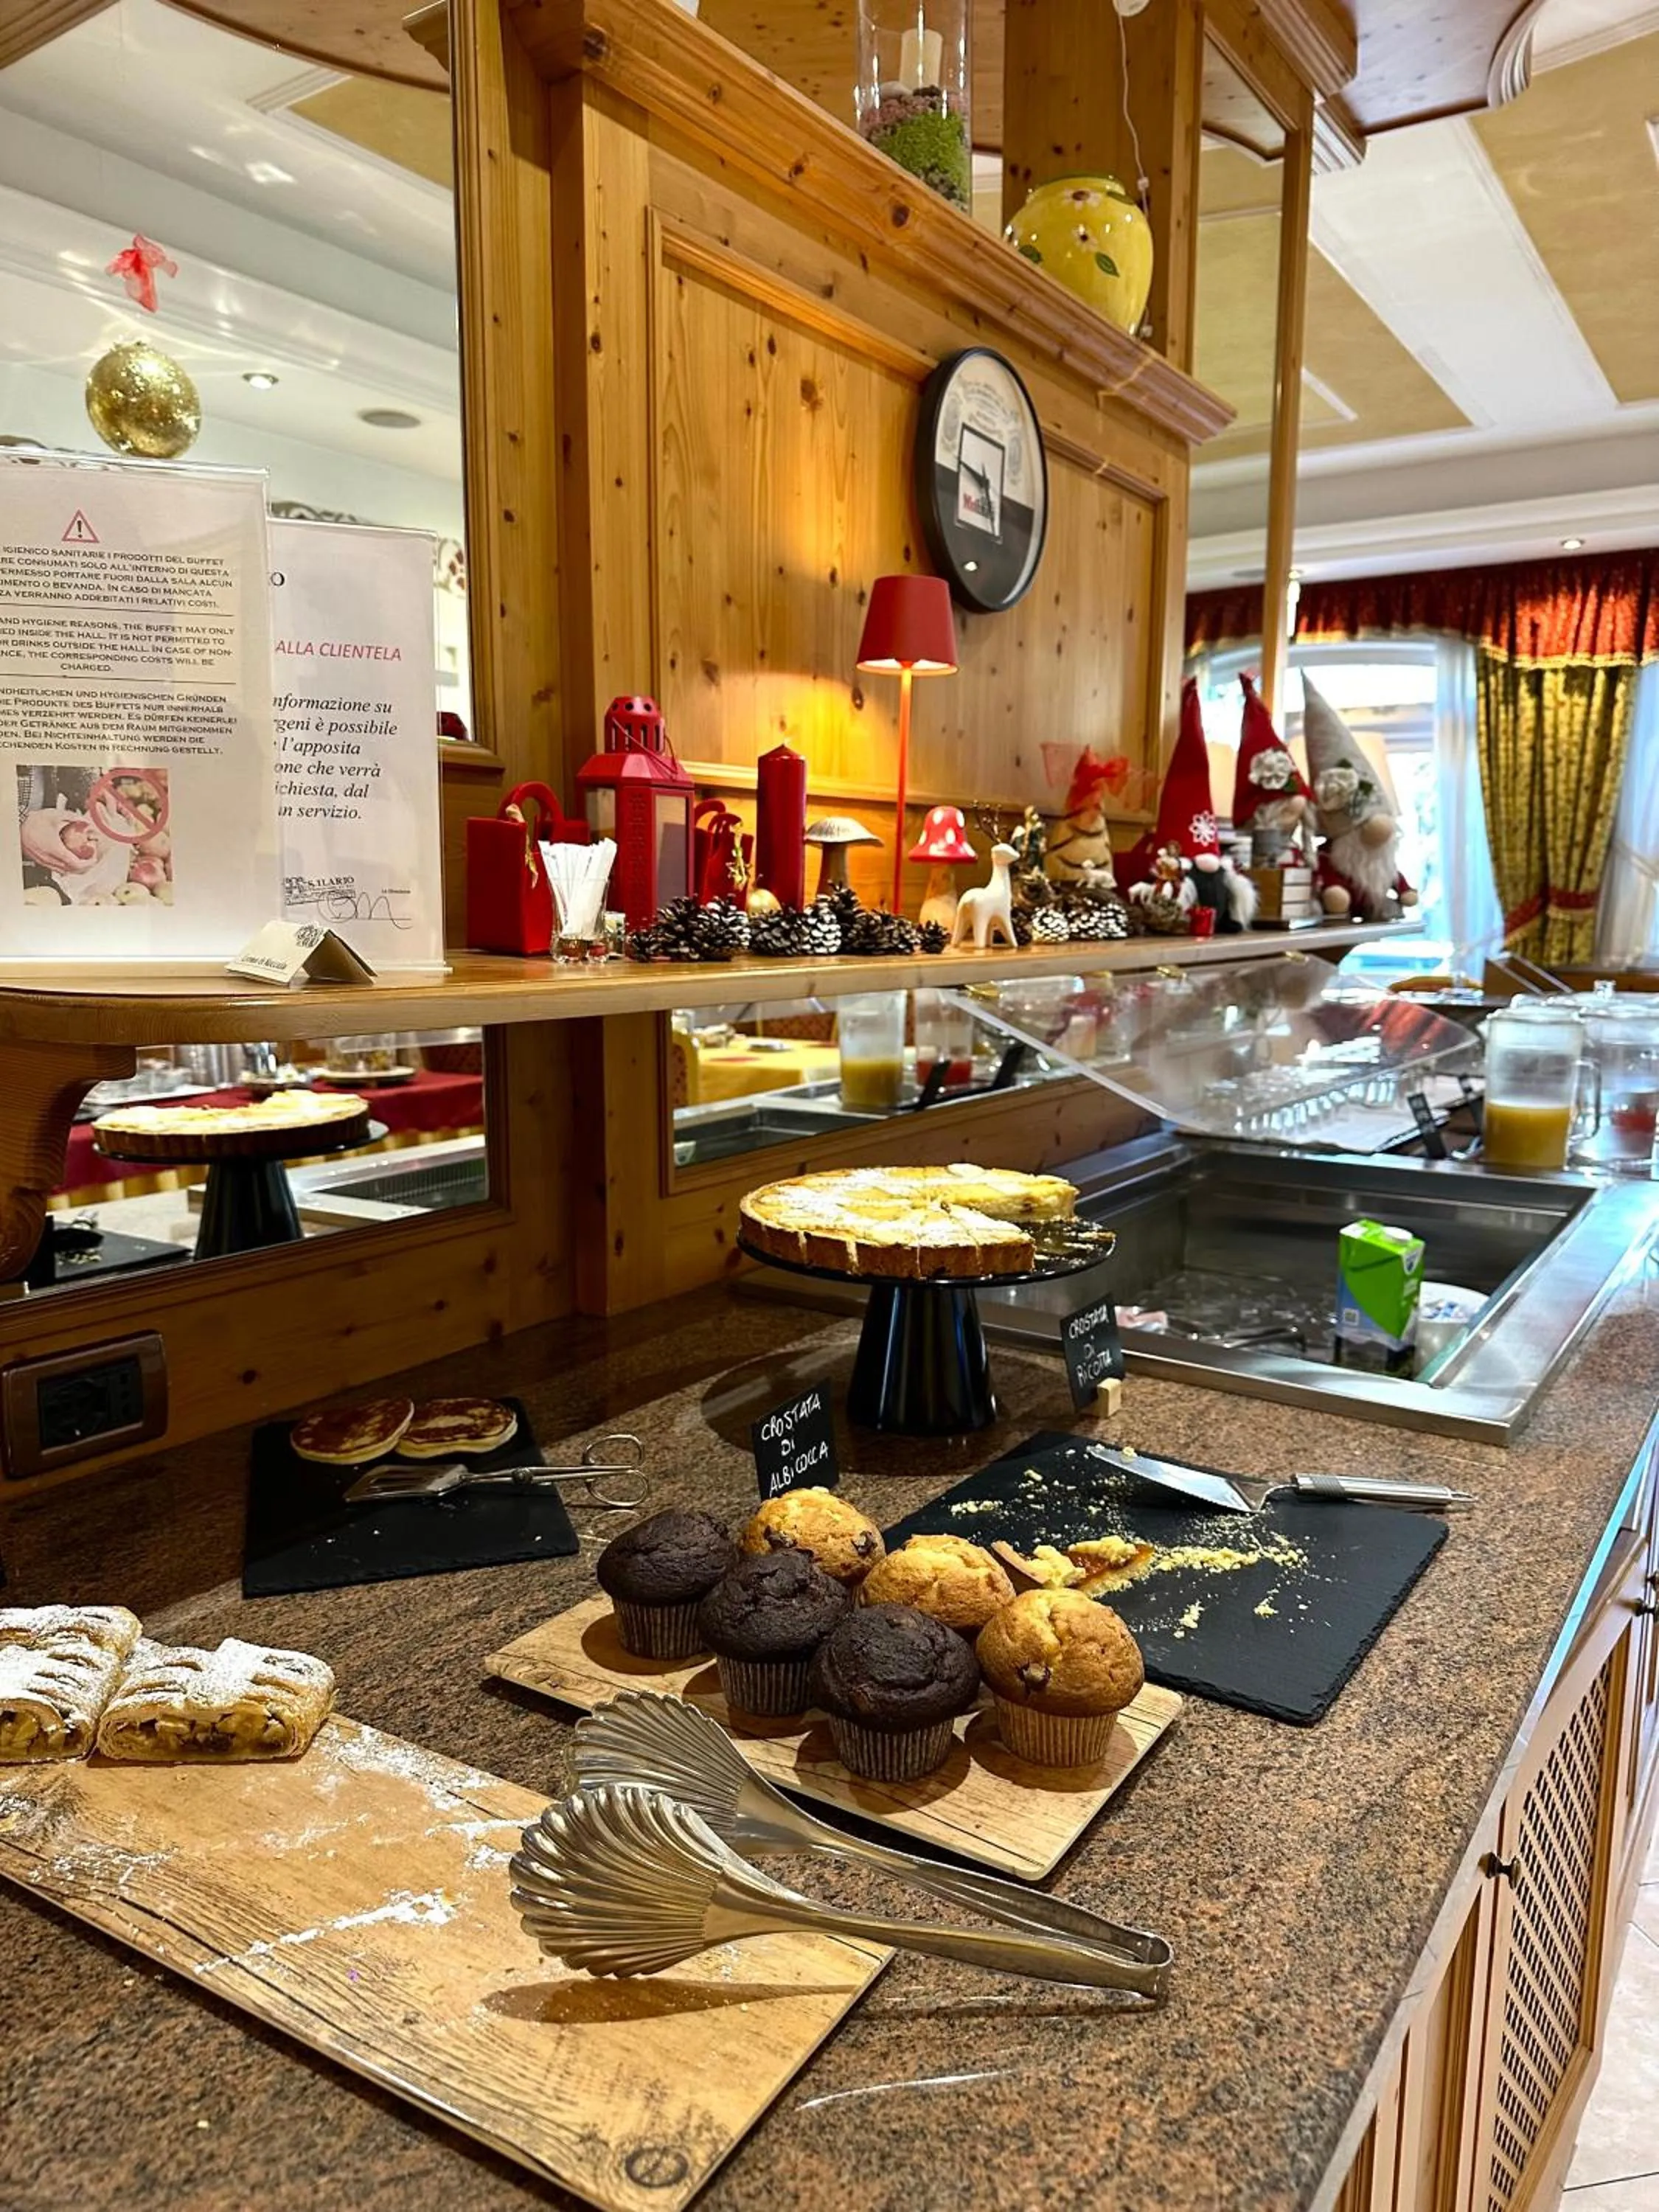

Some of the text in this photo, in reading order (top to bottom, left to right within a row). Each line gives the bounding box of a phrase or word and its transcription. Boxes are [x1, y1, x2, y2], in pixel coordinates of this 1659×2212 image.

[52, 549, 105, 558] SANITARIE
[113, 553, 162, 562] PRODOTTI
[165, 555, 184, 563] DEL
[187, 557, 223, 566] BUFFET
[18, 558, 78, 568] CONSUMATI
[110, 563, 175, 574] ALL'INTERNO
[190, 568, 229, 576] QUESTA
[0, 568, 50, 577] ERMESSO
[53, 571, 101, 580] PORTARE
[103, 573, 133, 581] FUORI
[136, 575, 168, 584] DALLA
[199, 579, 232, 587] ALCUN
[0, 580, 40, 588] IMENTO
[53, 582, 105, 591] BEVANDA.
[121, 585, 147, 593] CASO
[164, 588, 212, 597] MANCATA
[14, 591, 72, 600] VERRANNO
[74, 594, 133, 604] ADDEBITATI
[142, 598, 185, 606] RELATIVI
[22, 619, 68, 627] HYGIENE
[145, 625, 182, 633] BUFFET
[12, 639, 50, 647] DRINKS
[53, 641, 96, 650] OUTSIDE
[152, 644, 162, 653] IN
[165, 646, 191, 654] CASE
[155, 636, 210, 644] PERMITTED
[51, 652, 138, 663] CORRESPONDING
[141, 655, 173, 664] COSTS
[275, 640, 402, 661] ALLA CLIENTELA
[76, 690, 98, 698] UND
[100, 692, 174, 701] HYGIENISCHEN
[14, 698, 70, 707] PRODUKTE
[95, 700, 141, 710] BUFFETS
[167, 705, 223, 713] INNERHALB
[374, 702, 392, 714] su
[21, 710, 77, 718] VERZEHRT
[187, 715, 237, 724] KEINERLEI
[127, 723, 156, 731] RAUM
[159, 725, 232, 734] MITGENOMMEN
[315, 717, 324, 731] è
[327, 720, 397, 736] possibile
[44, 731, 141, 741] NICHTEINHALTUNG
[143, 735, 186, 743] WERDEN
[55, 742, 97, 751] KOSTEN
[112, 745, 170, 753] RECHNUNG
[282, 737, 361, 757] l'apposita
[307, 760, 335, 775] che
[340, 763, 381, 778] verrà
[344, 783, 369, 798] dal
[296, 804, 361, 819] servizio.
[1069, 1304, 1110, 1339] CROSTATA
[761, 1393, 821, 1441] CROSTATA
